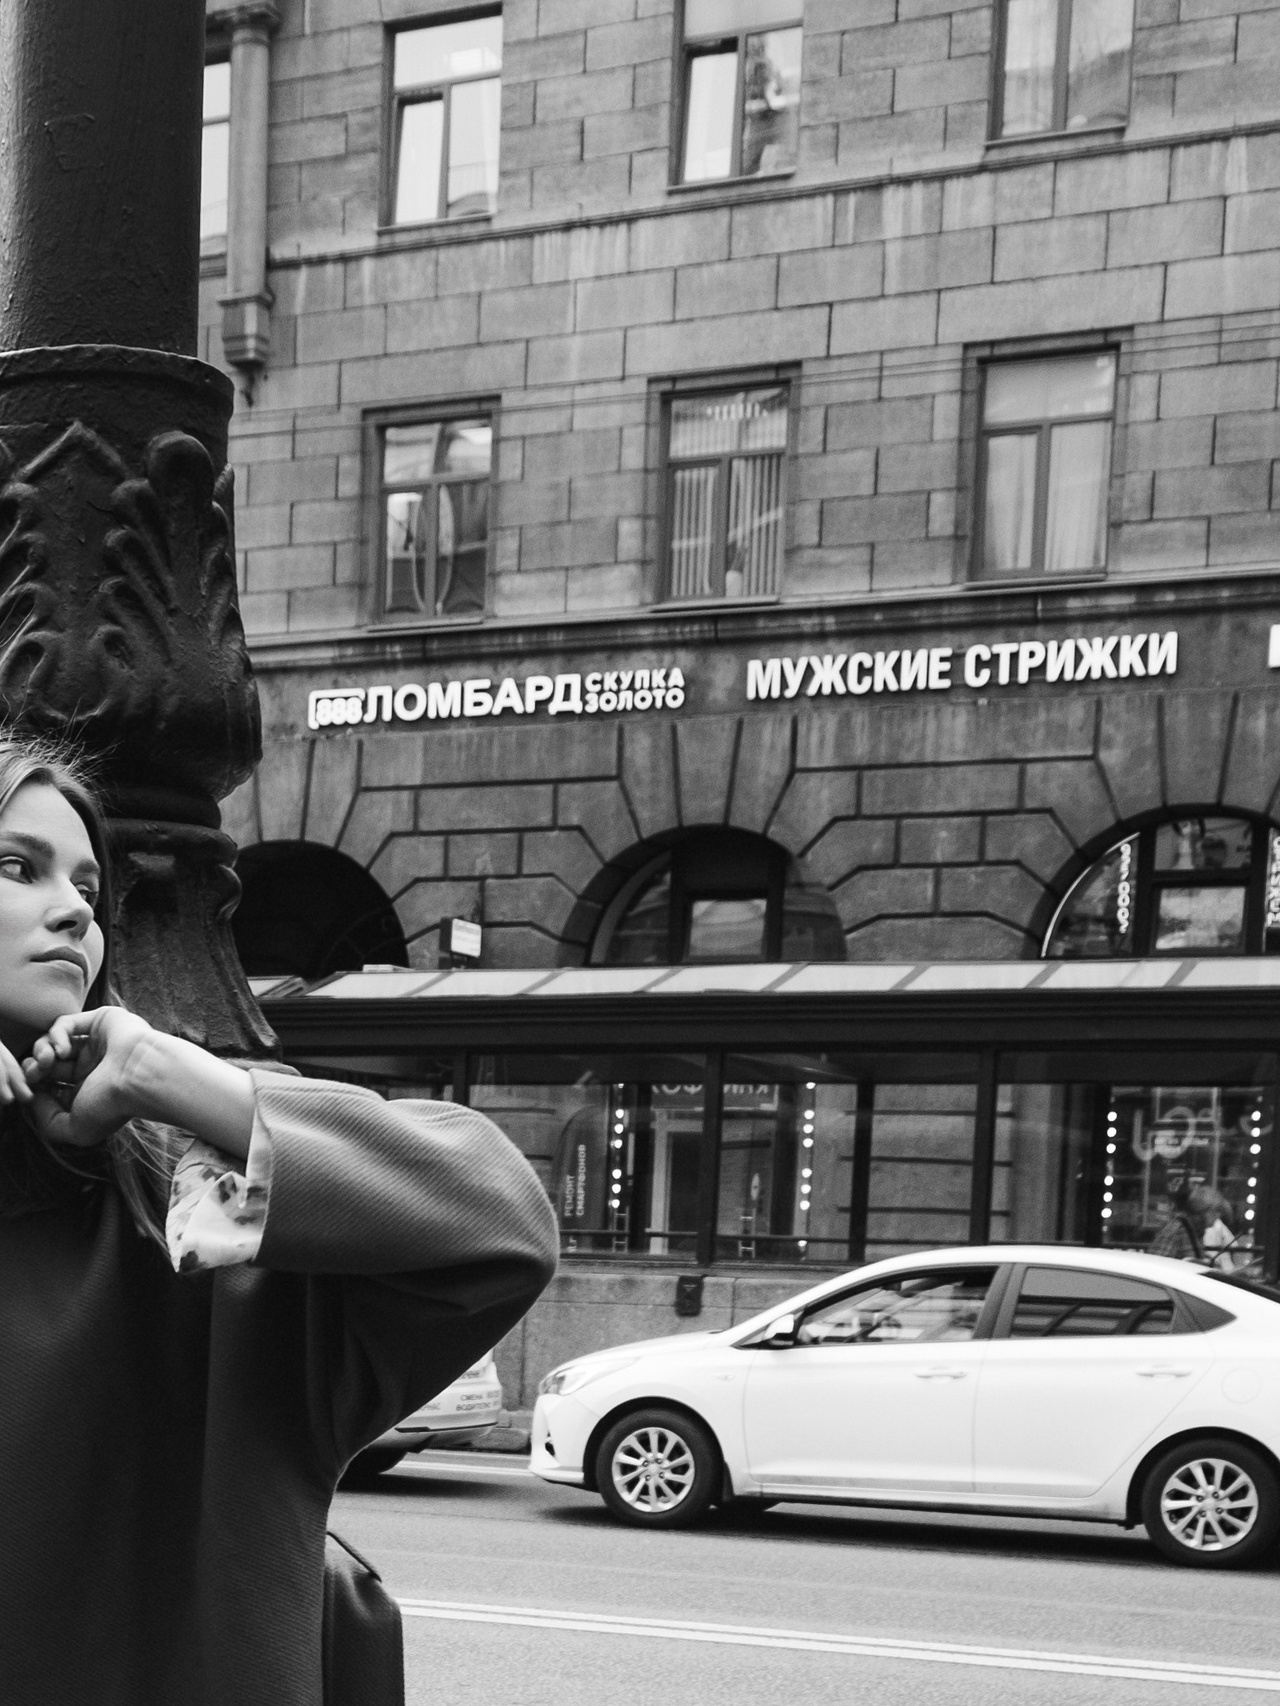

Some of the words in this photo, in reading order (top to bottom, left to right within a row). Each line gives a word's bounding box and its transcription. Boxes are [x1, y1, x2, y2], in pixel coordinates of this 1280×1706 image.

[584, 667, 685, 693] СКУПКА
[746, 646, 953, 700] МУЖСКИЕ
[963, 630, 1179, 688] СТРИЖКИ
[363, 673, 583, 723] ЛОМБАРД
[584, 687, 685, 714] ЗОЛОТО
[564, 1174, 575, 1217] РЕМОНТ
